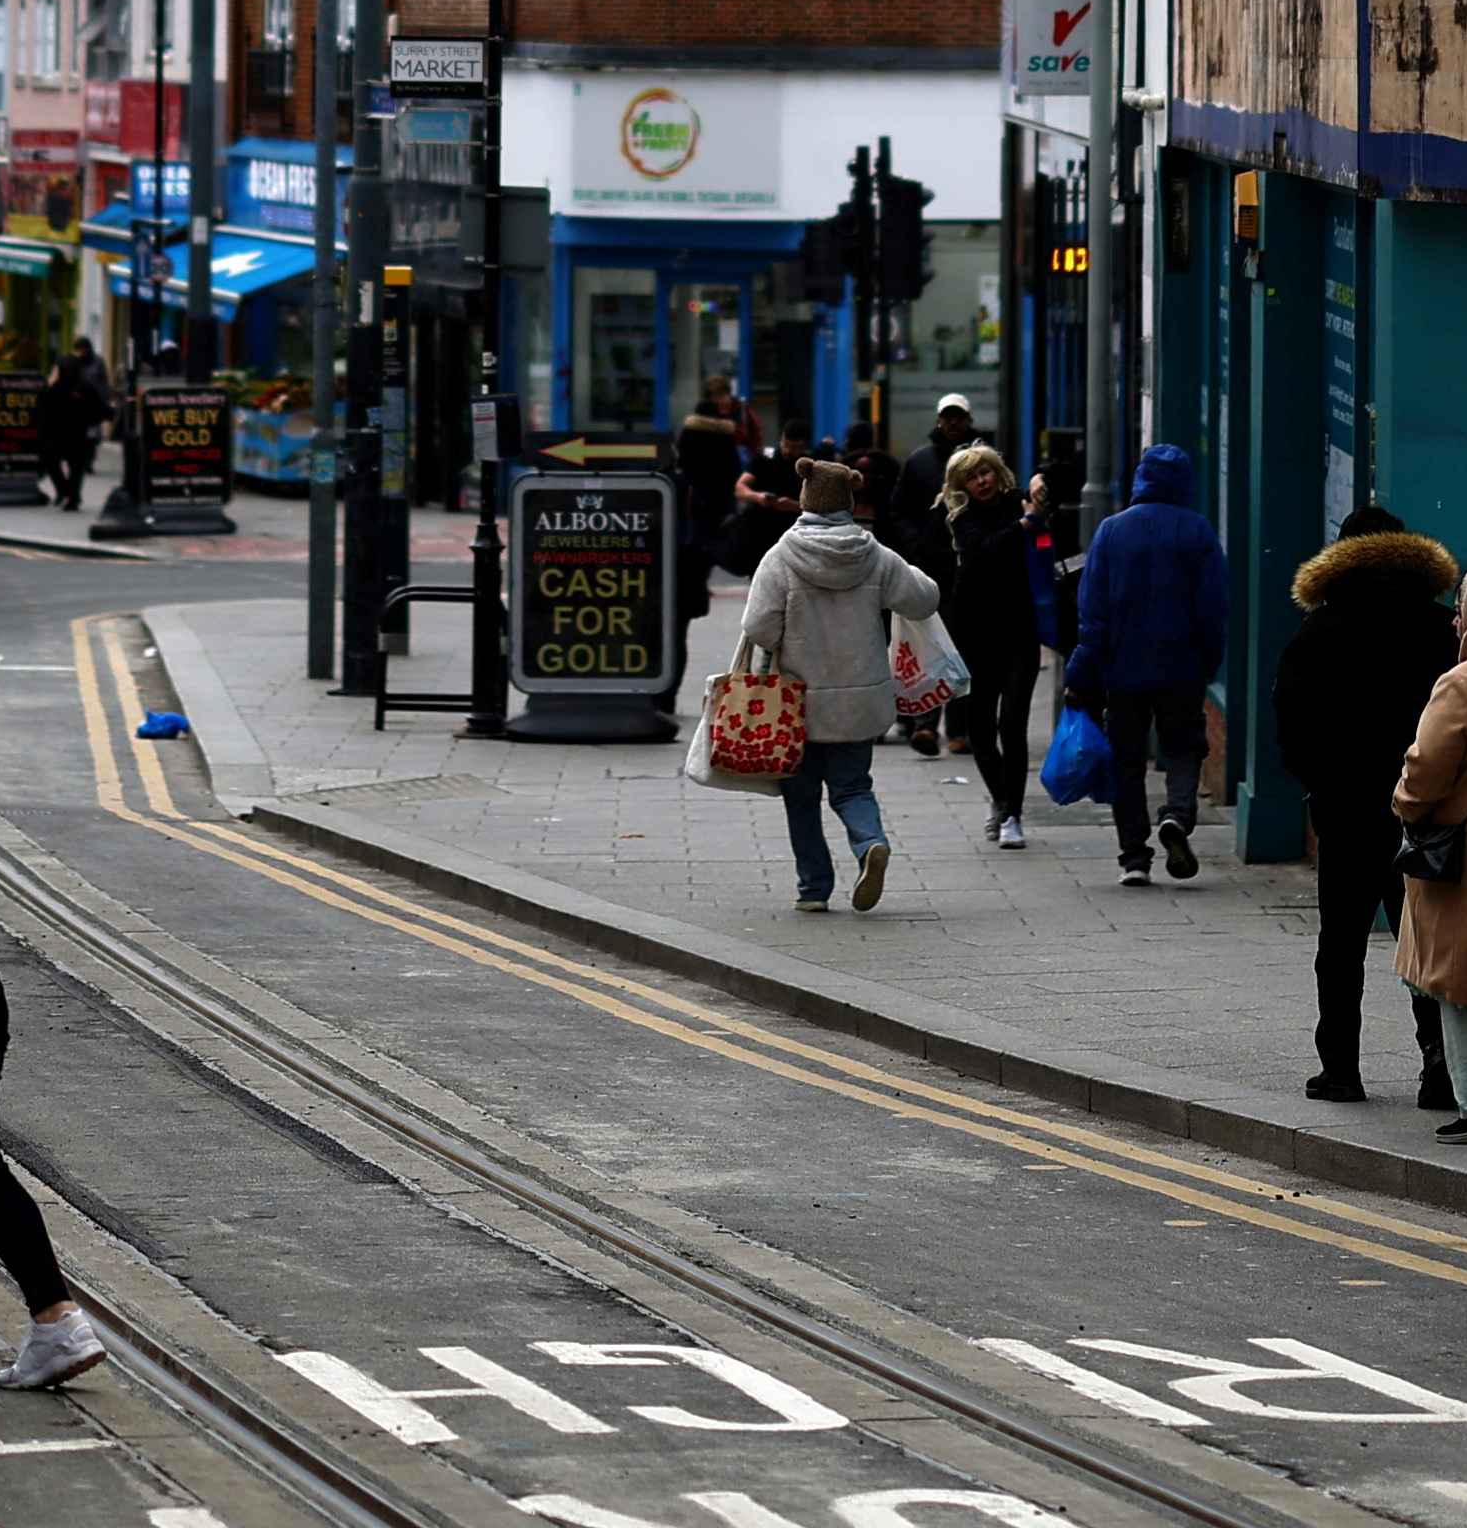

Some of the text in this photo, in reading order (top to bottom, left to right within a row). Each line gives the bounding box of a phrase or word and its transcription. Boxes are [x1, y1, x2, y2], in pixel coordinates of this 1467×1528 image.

[394, 45, 480, 57] SURREY STREET
[394, 60, 480, 79] MARKET
[1027, 49, 1091, 73] save
[152, 408, 220, 426] WE BUY
[161, 429, 212, 447] GOLD
[534, 511, 650, 532] ALBONE
[540, 535, 631, 548] JEWELLERS
[533, 552, 652, 564] PAWNBROKERS
[539, 568, 646, 598] CASH
[554, 606, 634, 636] FOR
[536, 643, 649, 673] GOLD
